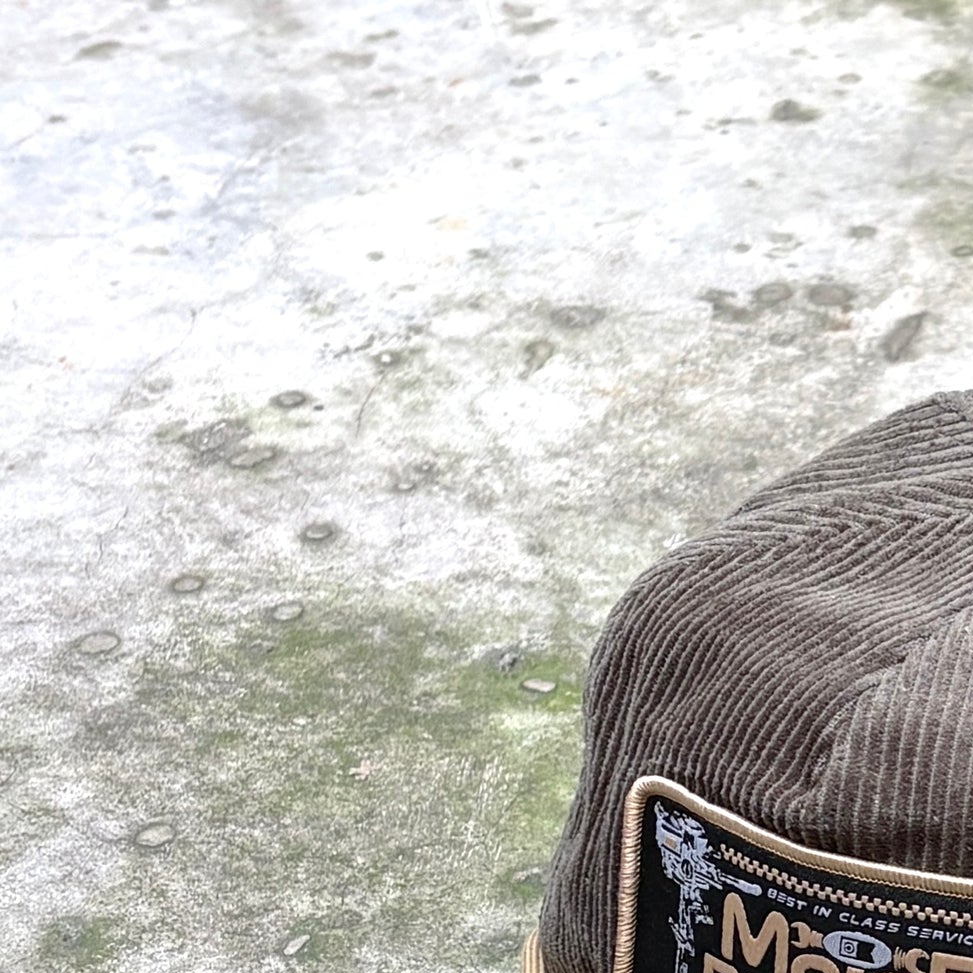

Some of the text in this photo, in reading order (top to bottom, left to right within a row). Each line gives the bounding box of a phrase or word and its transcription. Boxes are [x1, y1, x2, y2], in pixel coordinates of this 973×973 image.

[767, 888, 807, 911] BEST
[813, 904, 832, 918] IN
[839, 912, 901, 933] CLASS
